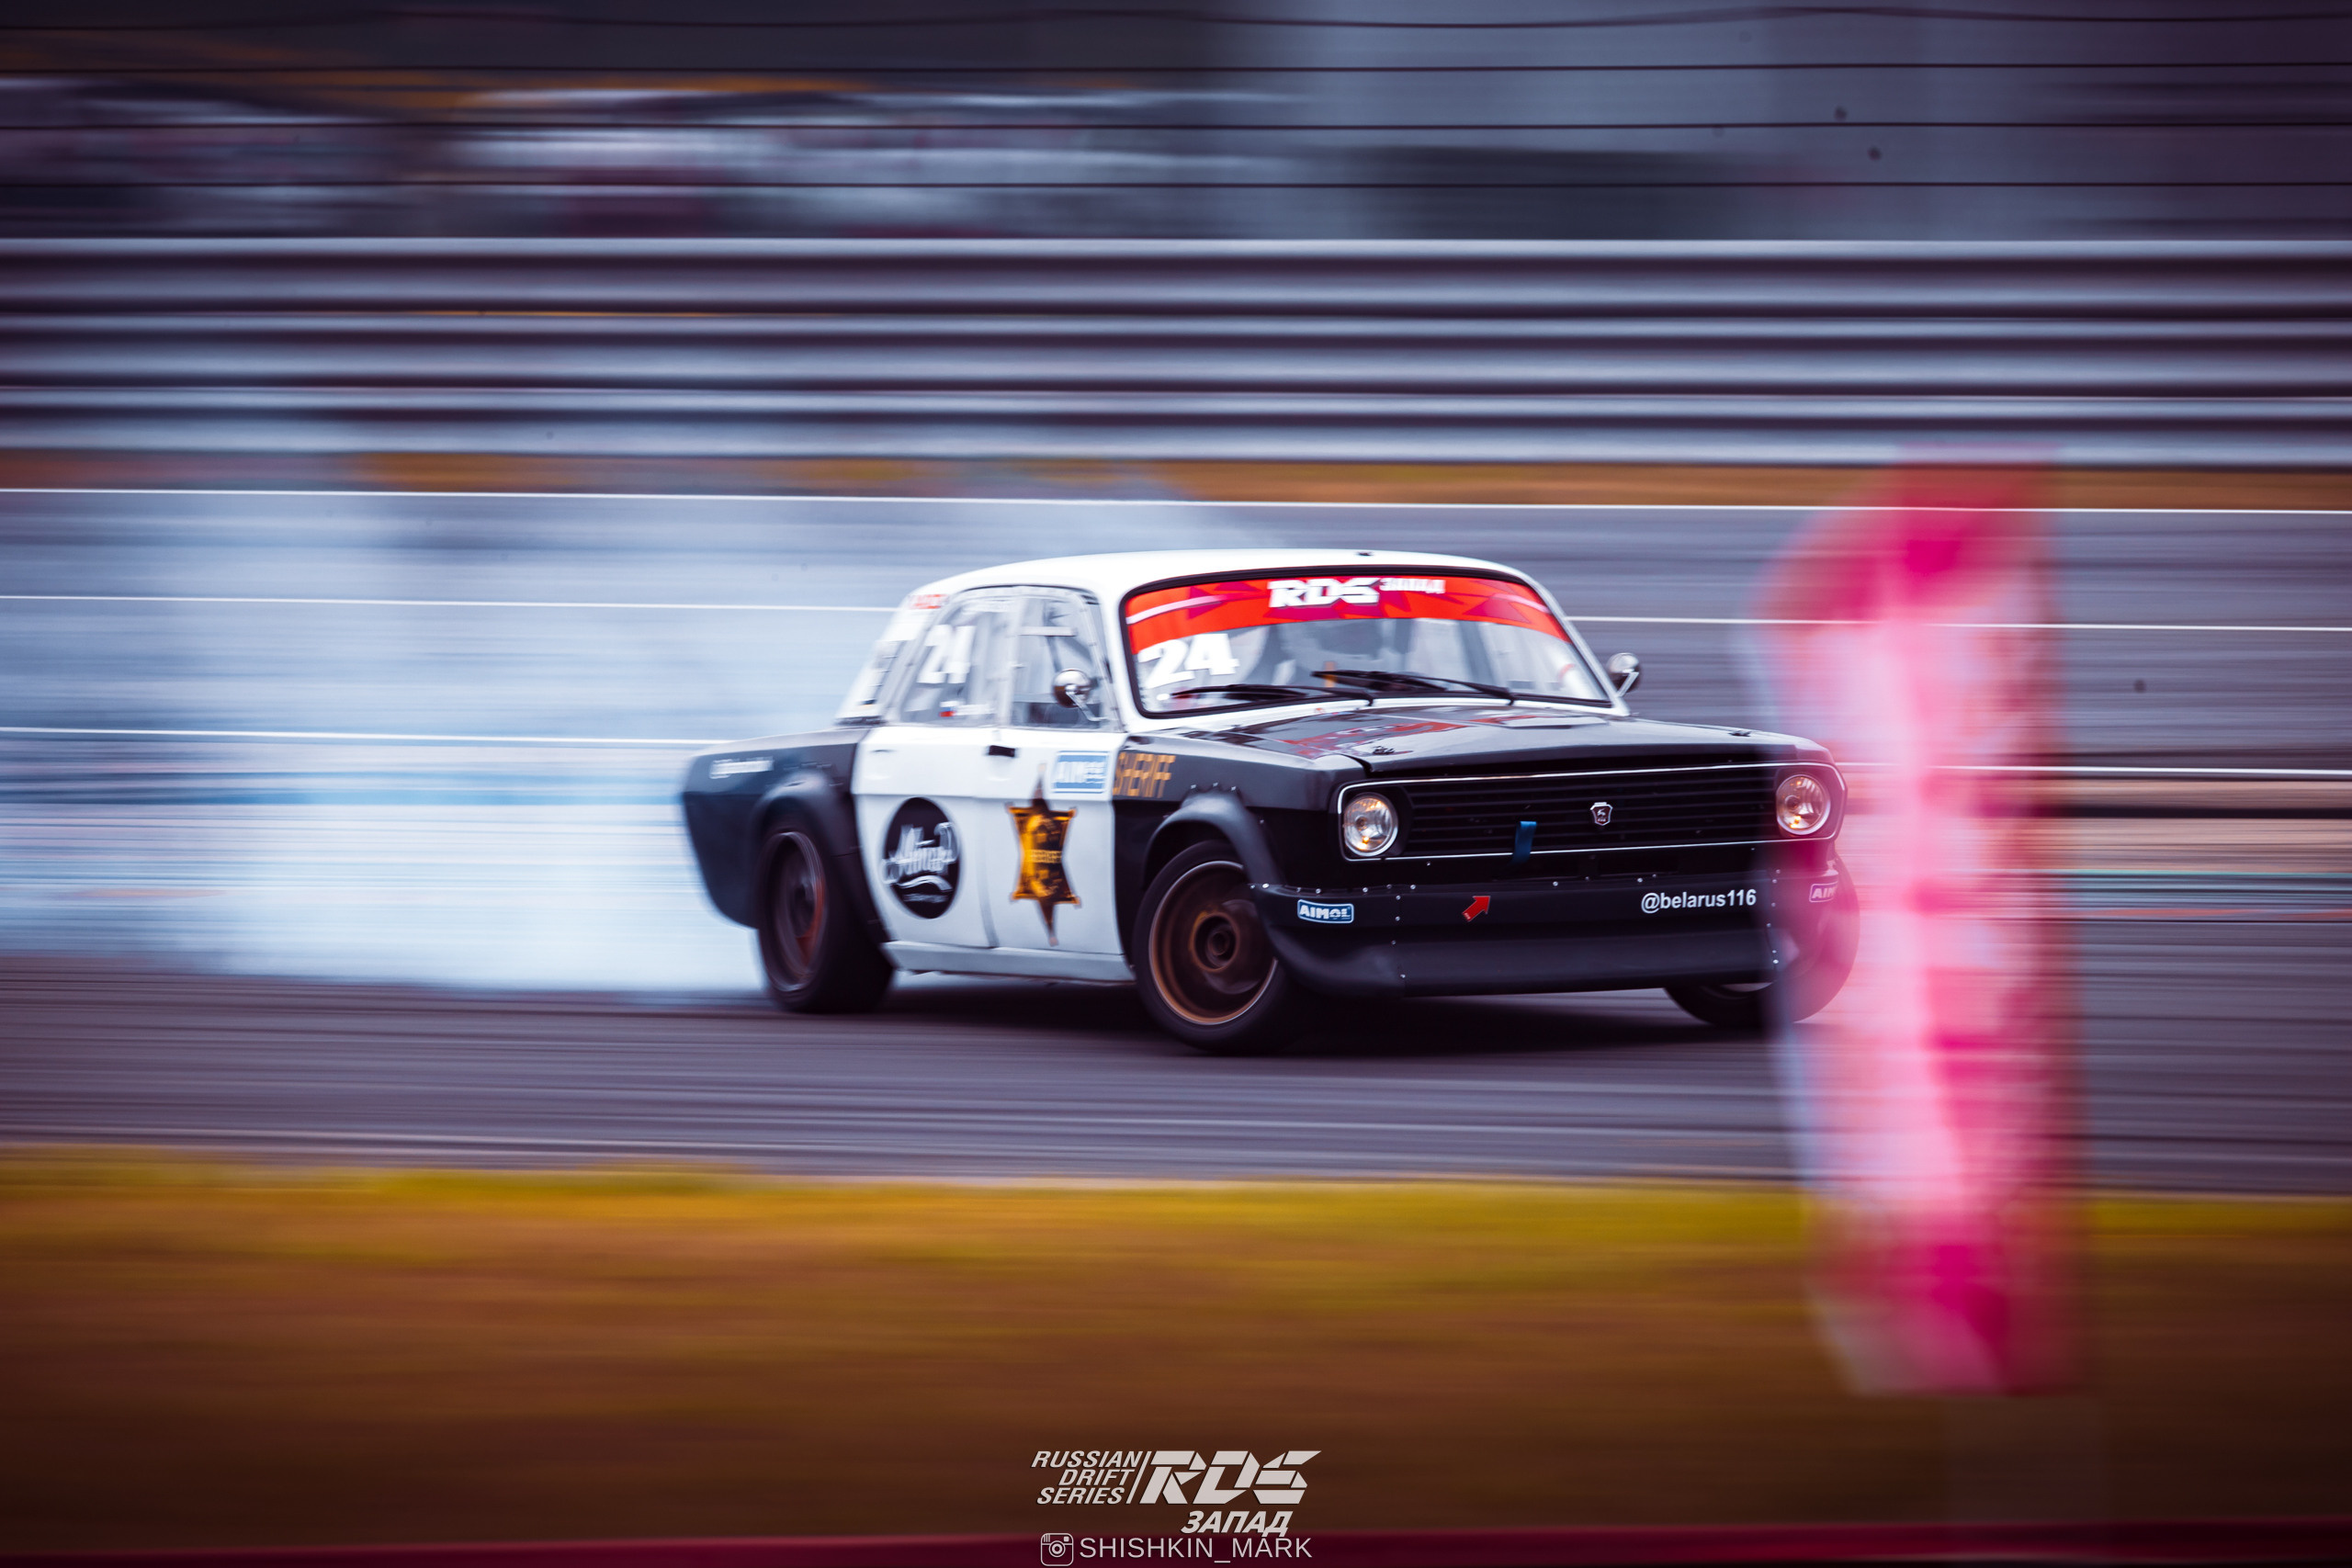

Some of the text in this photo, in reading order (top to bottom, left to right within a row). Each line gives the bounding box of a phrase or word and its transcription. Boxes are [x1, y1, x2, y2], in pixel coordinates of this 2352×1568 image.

[1267, 577, 1379, 608] RDS
[1137, 633, 1239, 689] 24
[1299, 904, 1351, 920] AIMOL
[1641, 888, 1757, 914] @belarus116
